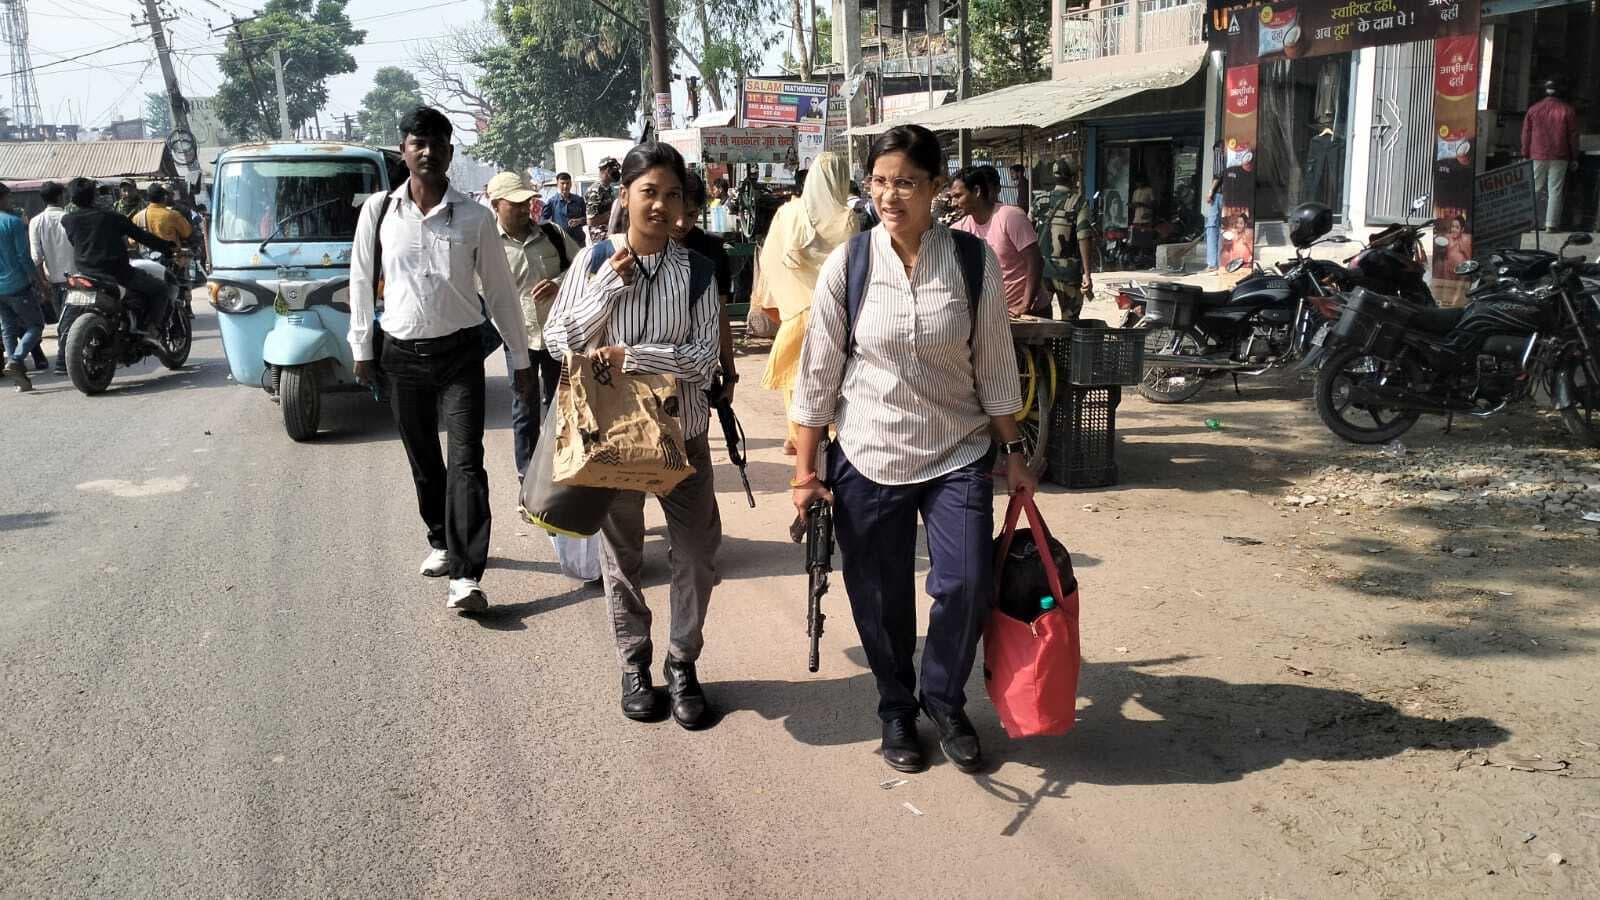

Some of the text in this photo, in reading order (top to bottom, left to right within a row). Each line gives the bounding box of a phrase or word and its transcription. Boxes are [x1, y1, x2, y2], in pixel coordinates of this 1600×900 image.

[1331, 2, 1371, 19] स्वादिष्ट
[1441, 5, 1459, 21] दही
[1315, 26, 1331, 39] अब
[1358, 17, 1369, 32] के
[1373, 16, 1393, 31] दाम
[1398, 11, 1406, 26] पे
[746, 80, 826, 94] SALAM MATHEMATICS
[1449, 74, 1464, 87] दही
[1480, 168, 1523, 192] IGNOU
